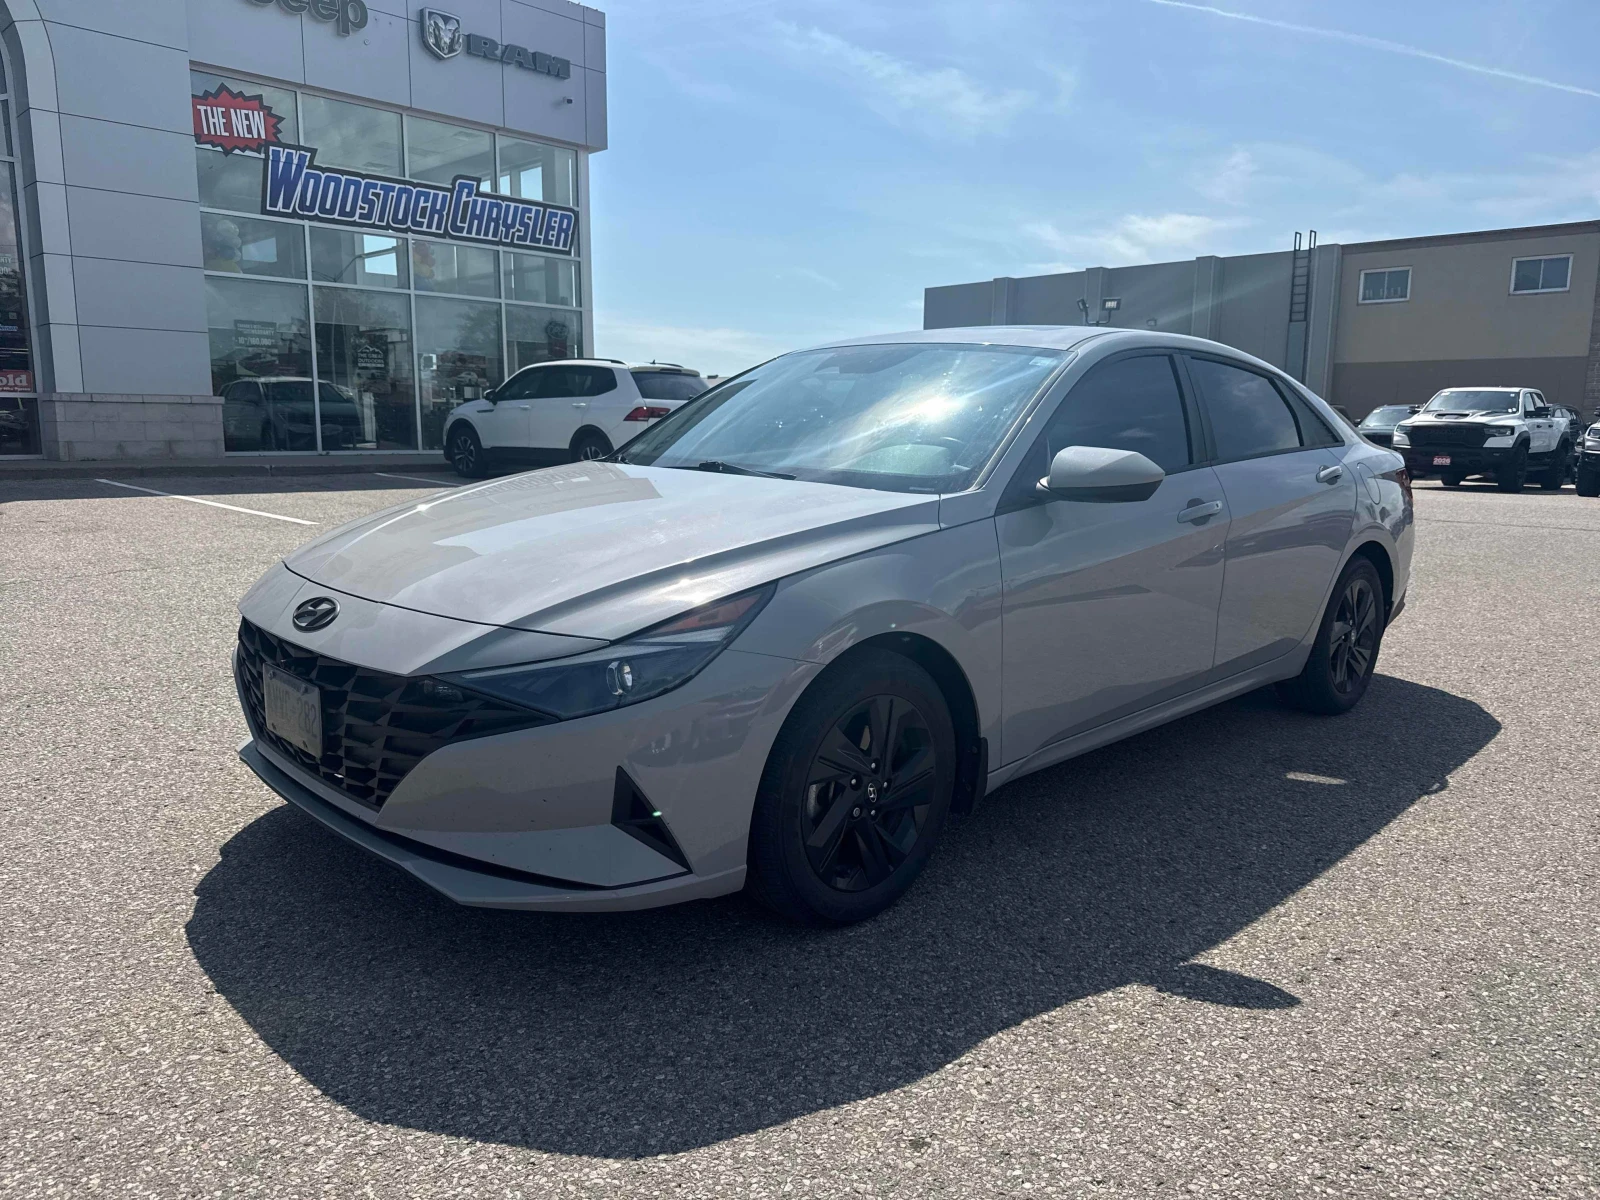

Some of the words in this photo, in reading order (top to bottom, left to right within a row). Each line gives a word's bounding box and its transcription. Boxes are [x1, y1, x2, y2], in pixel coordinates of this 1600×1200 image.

[245, 0, 369, 36] ep
[468, 33, 571, 80] RAM
[197, 105, 230, 136] THE
[230, 109, 266, 139] NEW
